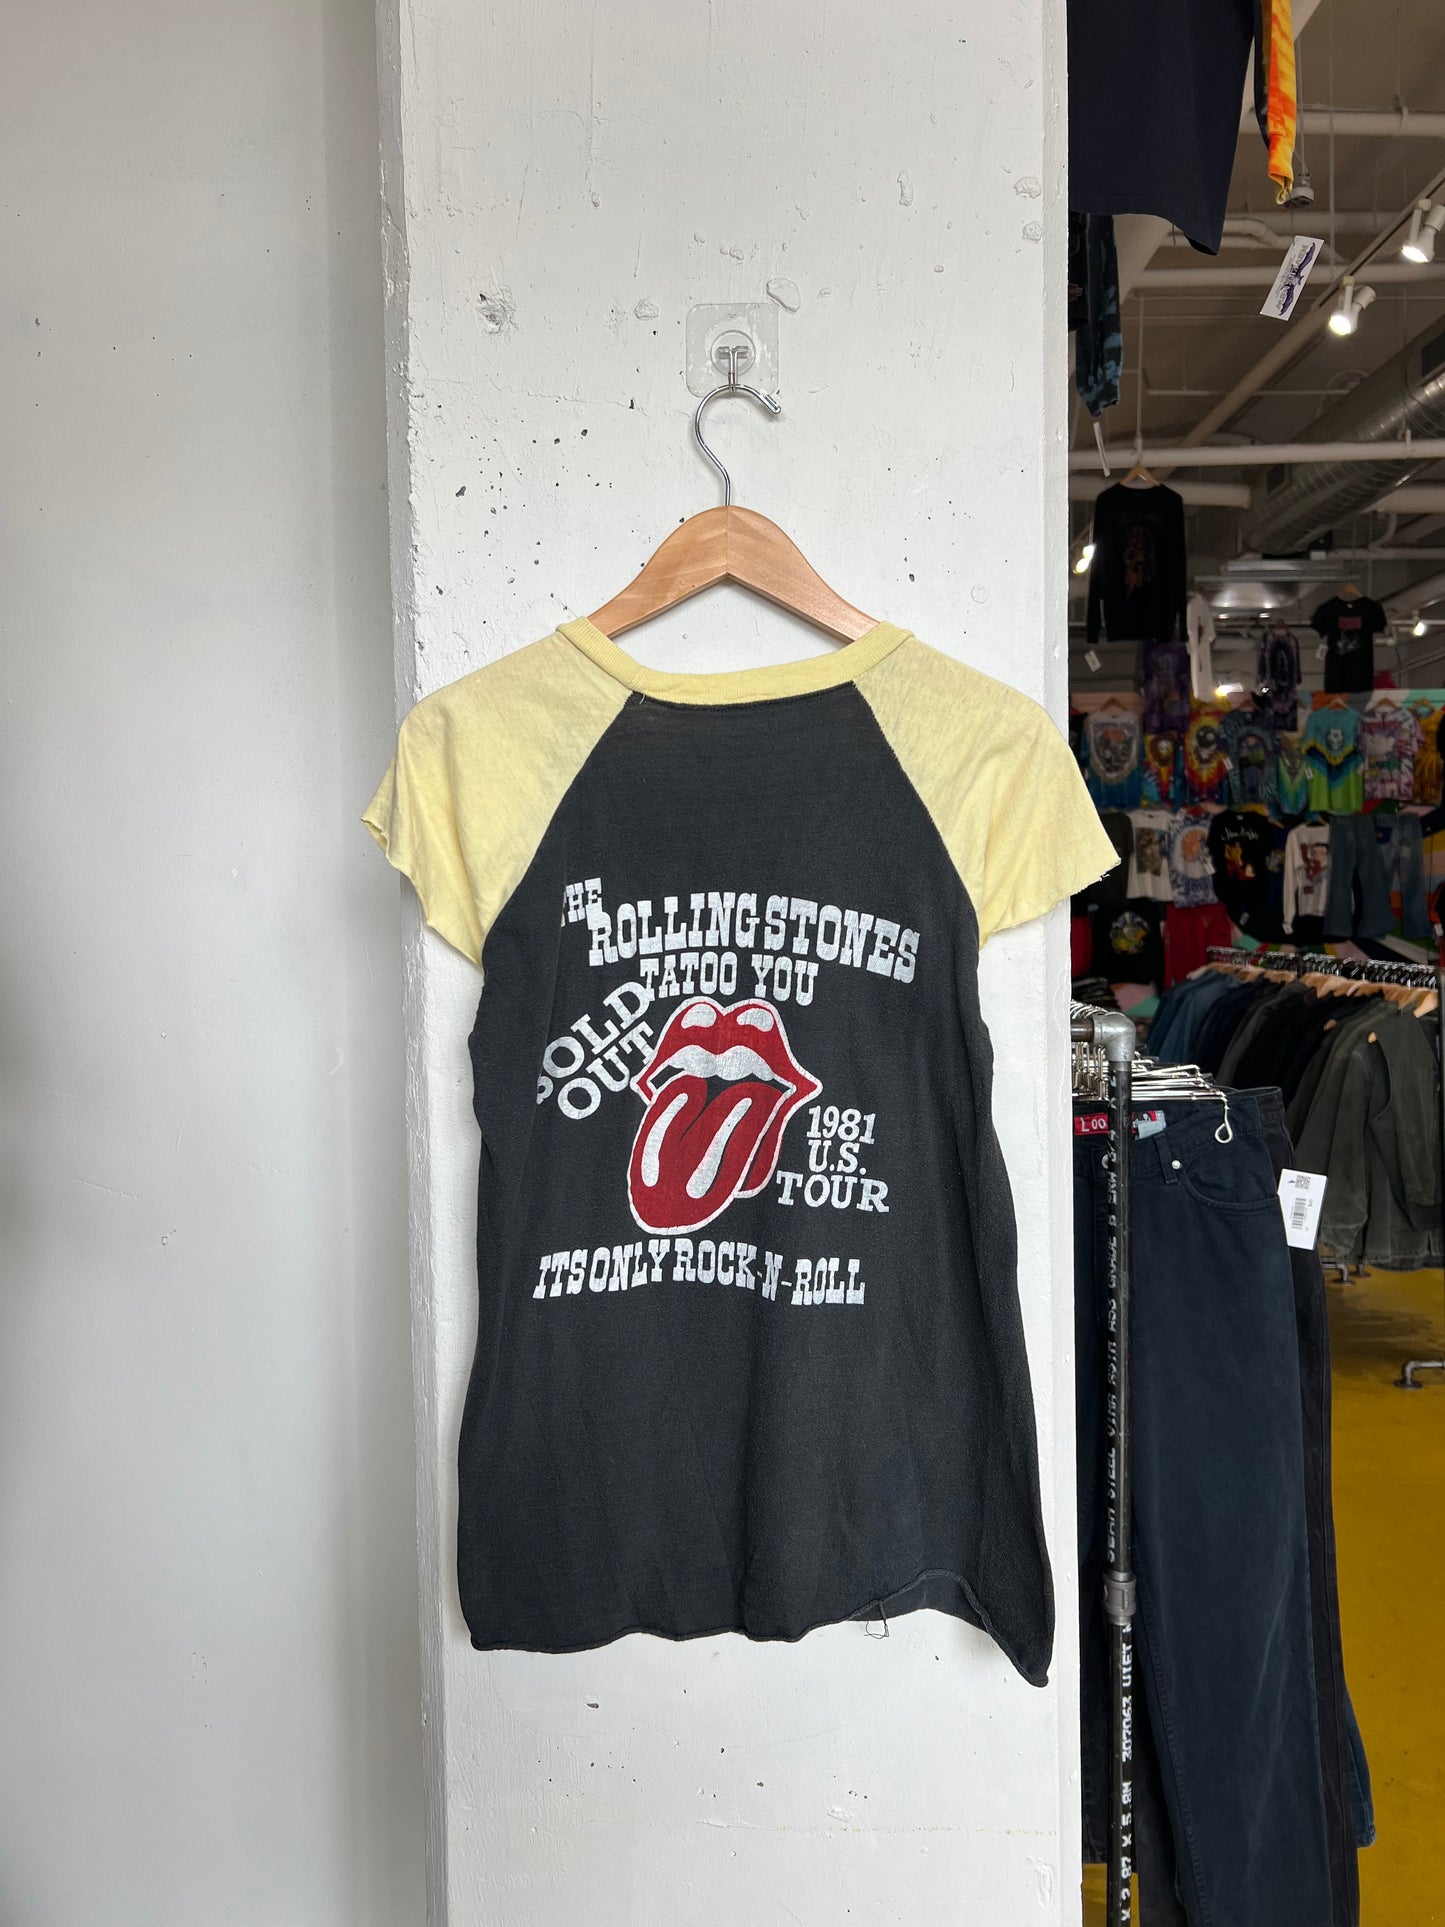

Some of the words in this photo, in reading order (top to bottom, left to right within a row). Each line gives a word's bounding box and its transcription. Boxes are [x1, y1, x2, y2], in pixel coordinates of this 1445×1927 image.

[561, 878, 602, 927] HE
[587, 892, 760, 966] ROLLING
[764, 895, 920, 984] STONES
[640, 951, 737, 1002] TATOO
[751, 954, 819, 1006] YOU
[558, 1021, 655, 1120] OUT
[806, 1105, 876, 1144] 1981
[808, 1139, 867, 1175] U.S.
[776, 1170, 890, 1213] TOUR
[532, 1249, 588, 1299] ITS
[589, 1239, 670, 1292] ONLY
